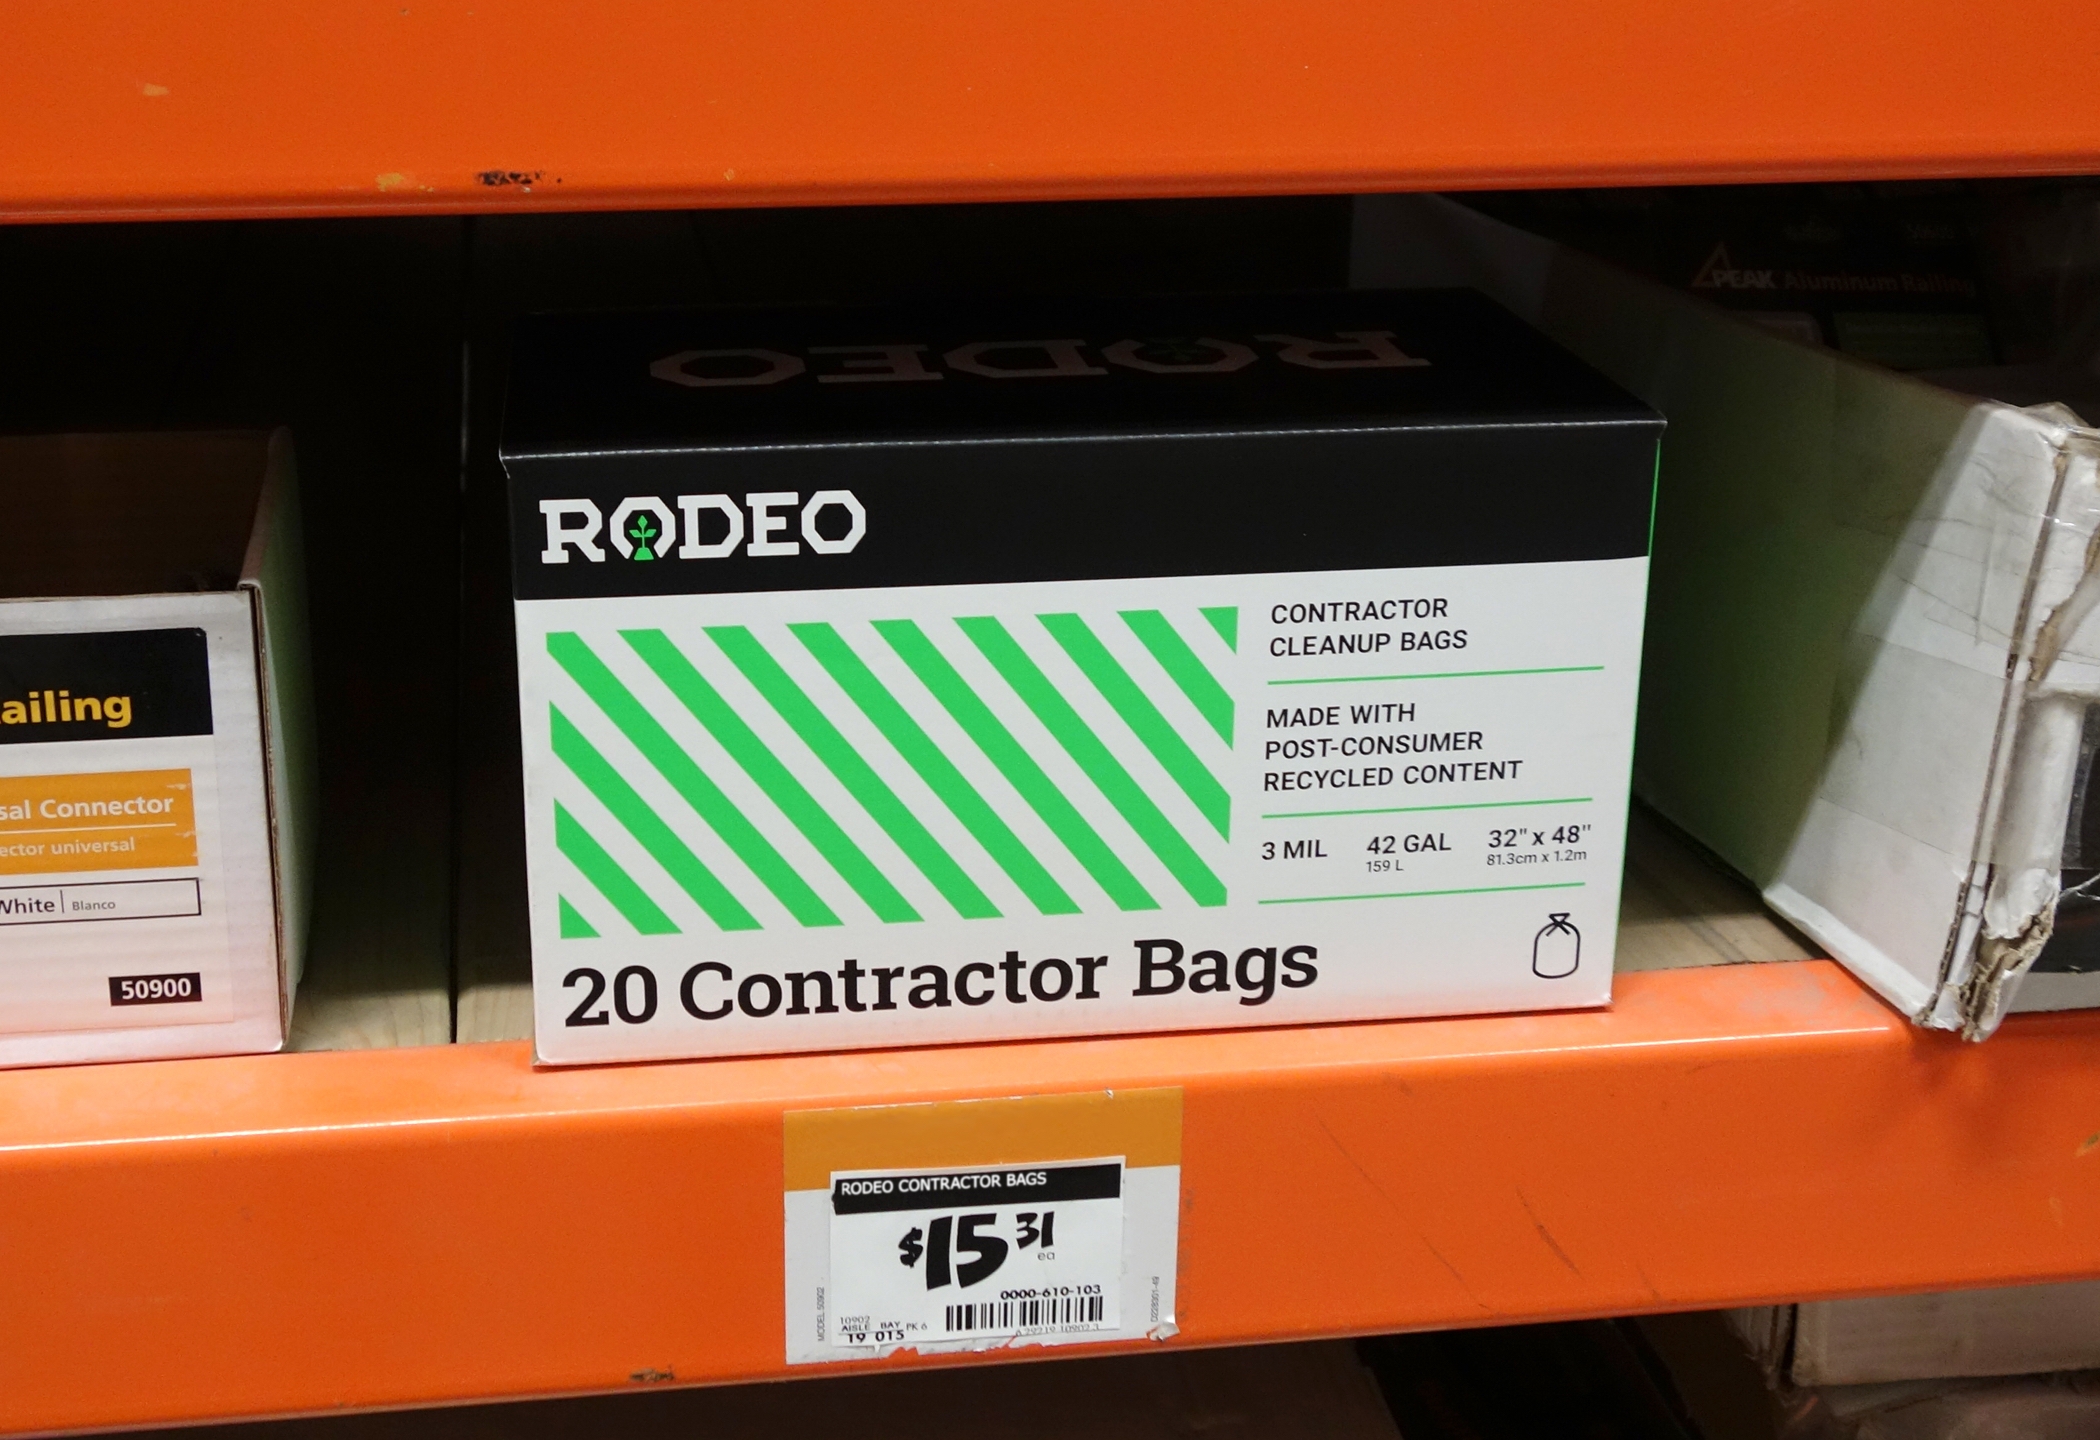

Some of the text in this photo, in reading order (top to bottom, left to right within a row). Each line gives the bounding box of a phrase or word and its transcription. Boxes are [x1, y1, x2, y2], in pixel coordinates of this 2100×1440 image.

[1711, 268, 1976, 299] PEAK Aluminum Railing
[649, 330, 1431, 388] RODEO
[539, 489, 867, 564] RODEO
[1271, 598, 1449, 624] CONTRACTOR
[1269, 630, 1468, 657] CLEANUP BAGS
[0, 690, 132, 728] ailing
[1266, 703, 1416, 728] MADE WITH
[1265, 731, 1483, 760] POST-CONSUMER
[1263, 760, 1523, 792] RECYCLED CONTENT
[39, 796, 174, 820] Connector
[51, 836, 135, 855] universal
[1367, 833, 1452, 855] 42 GAL
[1488, 824, 1592, 849] 32" x 48"
[1261, 839, 1328, 860] 3 MIL
[1486, 849, 1587, 867] 81.3cm x 1.2m
[1366, 859, 1404, 873] 159 L
[72, 899, 116, 912] Blanco
[120, 977, 192, 1000] 50900
[561, 938, 1319, 1028] 20 Contractor Bags
[841, 1171, 1047, 1197] RODEO CONTRACTOR BAGS
[1037, 1251, 1056, 1262] ea
[1000, 1284, 1101, 1300] 0000-610-103
[817, 1312, 826, 1342] MODEL
[841, 1315, 870, 1326] 10902
[841, 1321, 928, 1333] AISLE BAY PK 6
[847, 1330, 905, 1344] 19 015
